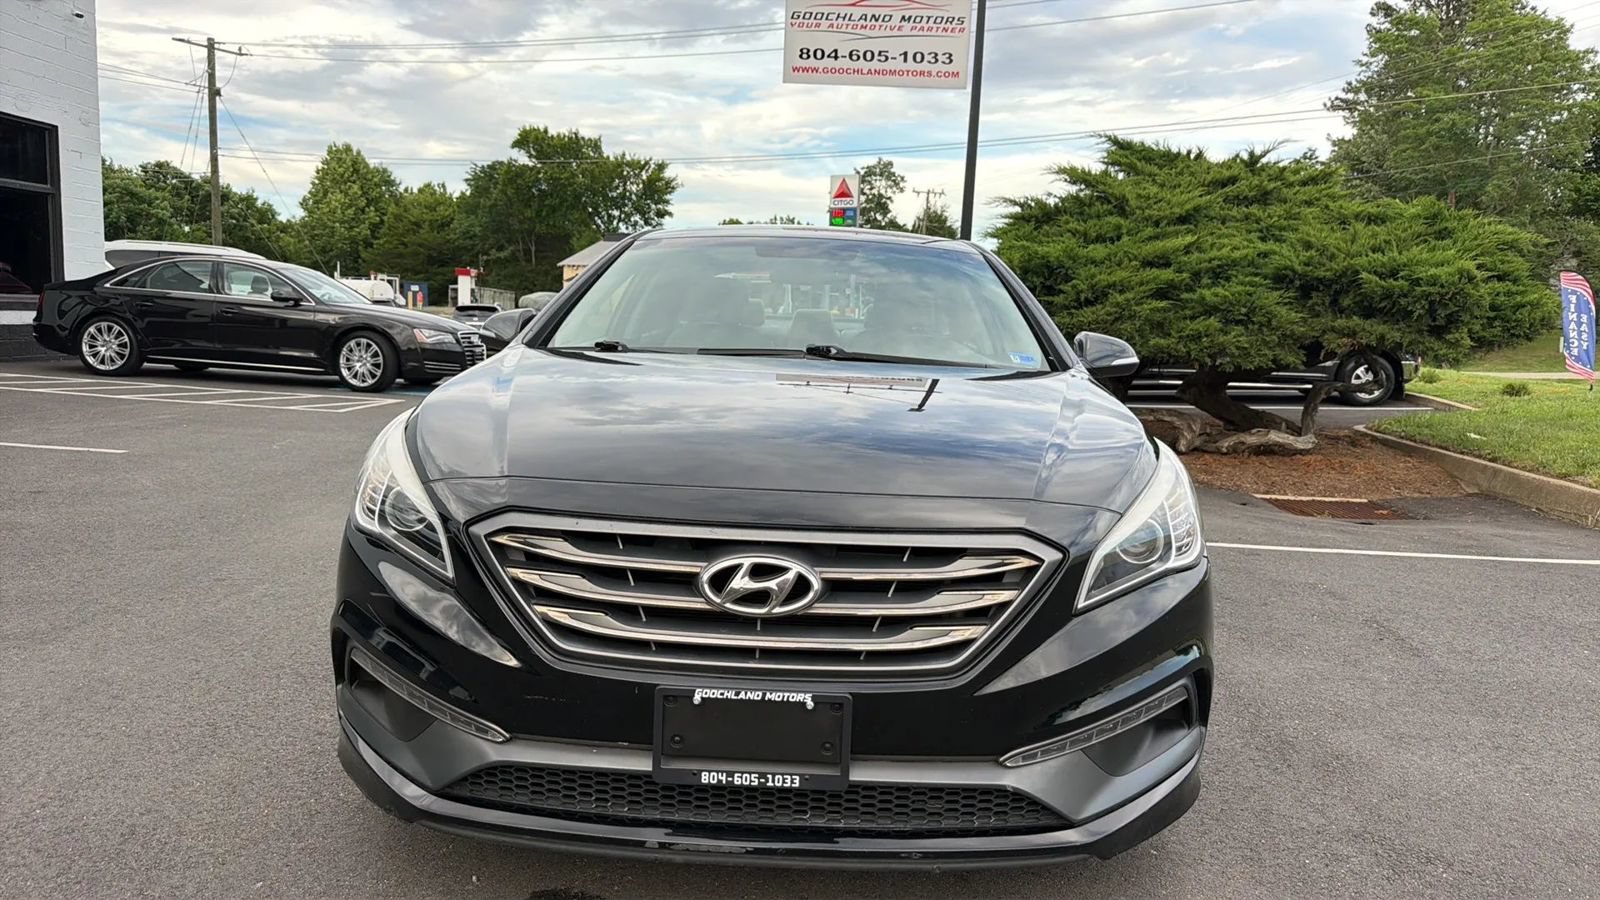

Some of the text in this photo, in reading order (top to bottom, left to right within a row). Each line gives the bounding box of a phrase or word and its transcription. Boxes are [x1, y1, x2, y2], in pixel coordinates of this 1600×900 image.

[790, 11, 967, 26] GOOCHLAND MOTORS
[790, 21, 967, 33] YOUR AUTOMOTIVE PARTNER
[798, 47, 954, 65] 804-605-1033
[791, 65, 960, 78] WWW.GOOCHLANDMOTORS.COM
[694, 688, 813, 703] GOOCHLAND MOTORS
[701, 771, 800, 787] 804-605-1033
